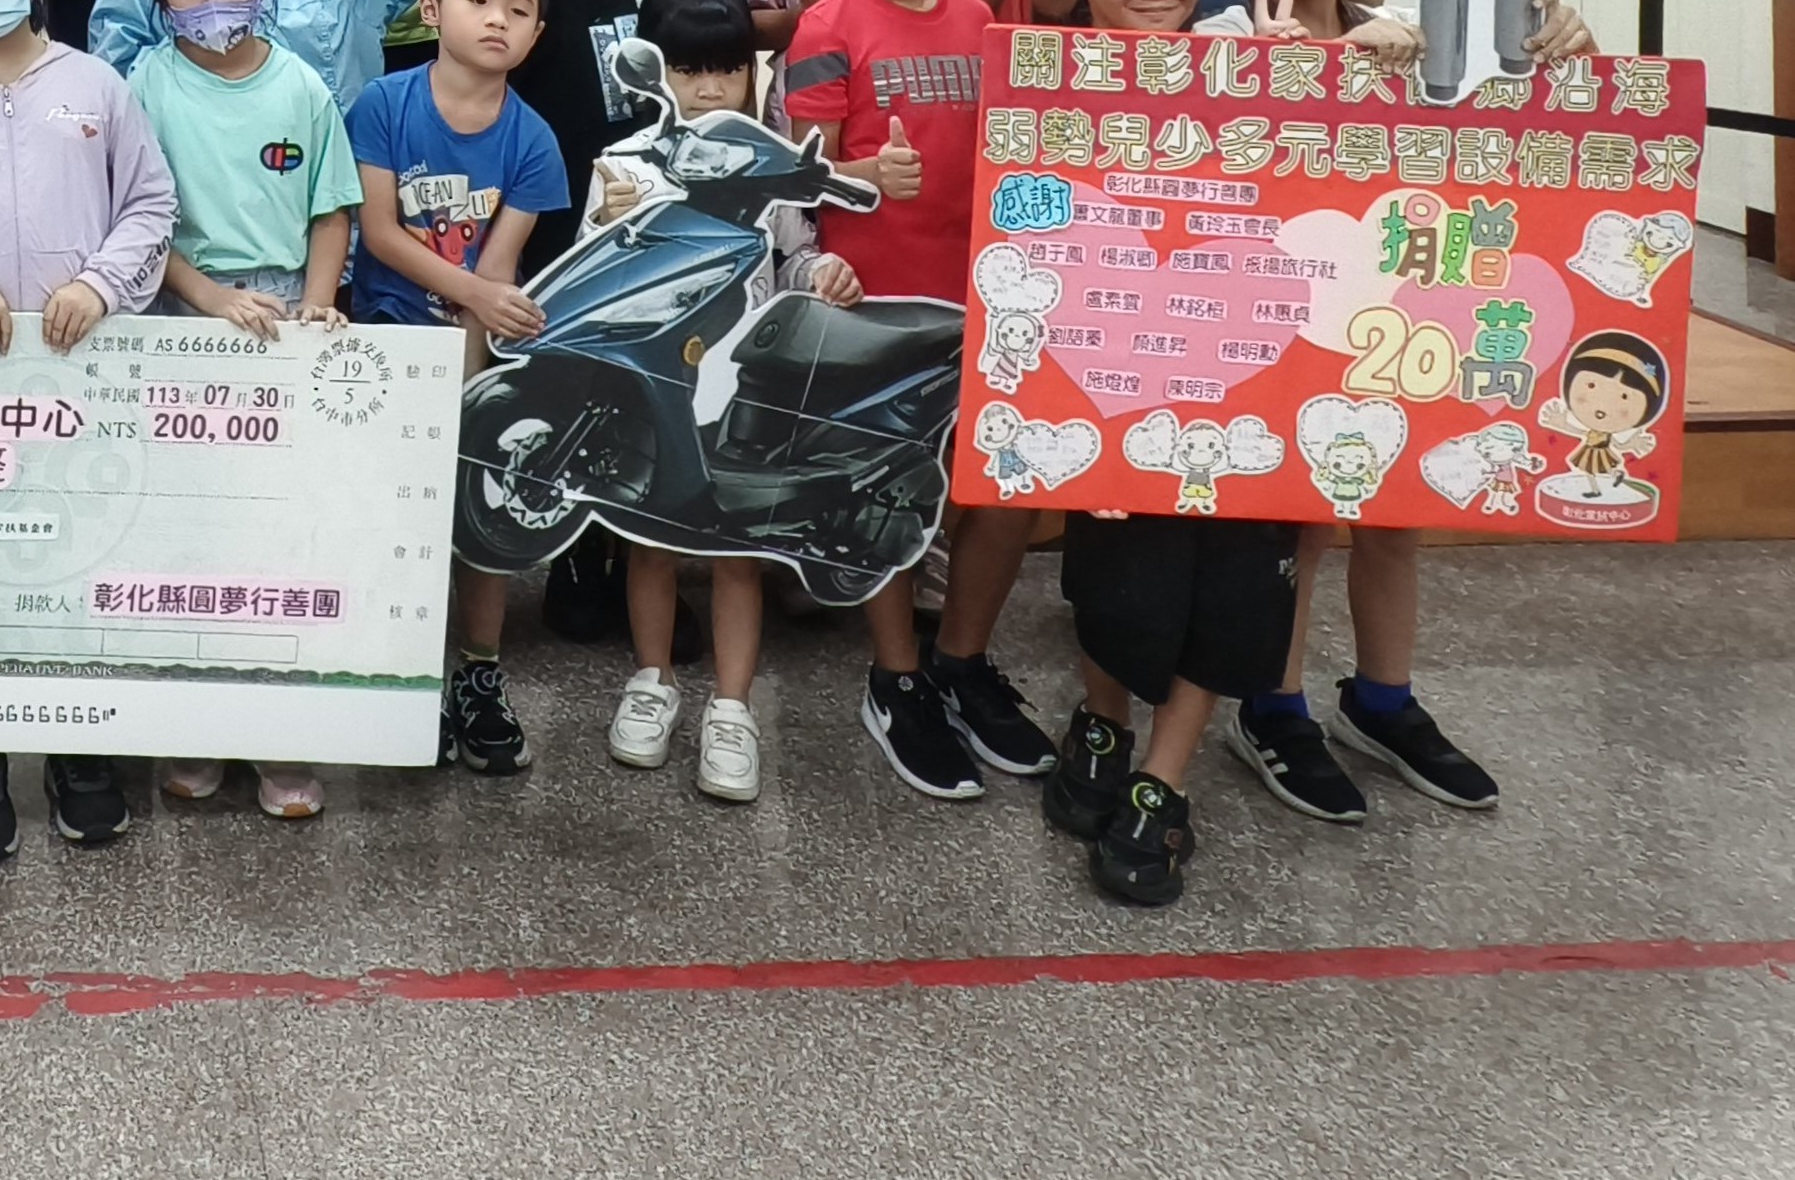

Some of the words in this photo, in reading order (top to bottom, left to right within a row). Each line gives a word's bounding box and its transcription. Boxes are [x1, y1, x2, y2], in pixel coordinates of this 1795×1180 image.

[1007, 29, 1674, 117] 關注彰化家扶鄉沿海
[982, 106, 1704, 193] 弱勢兒少多元學習設備需求
[1000, 176, 1071, 226] 感謝
[1378, 195, 1518, 290] 捐贈
[154, 338, 173, 353] AS
[177, 336, 269, 355] 6666666
[1340, 299, 1537, 410] 20萬
[340, 358, 363, 379] 19
[146, 386, 181, 406] 113
[204, 385, 231, 407] 07
[252, 386, 280, 409] 30
[343, 386, 355, 406] 5
[152, 412, 280, 444] 200,000
[91, 581, 342, 620] 彰化縣圓夢行善團
